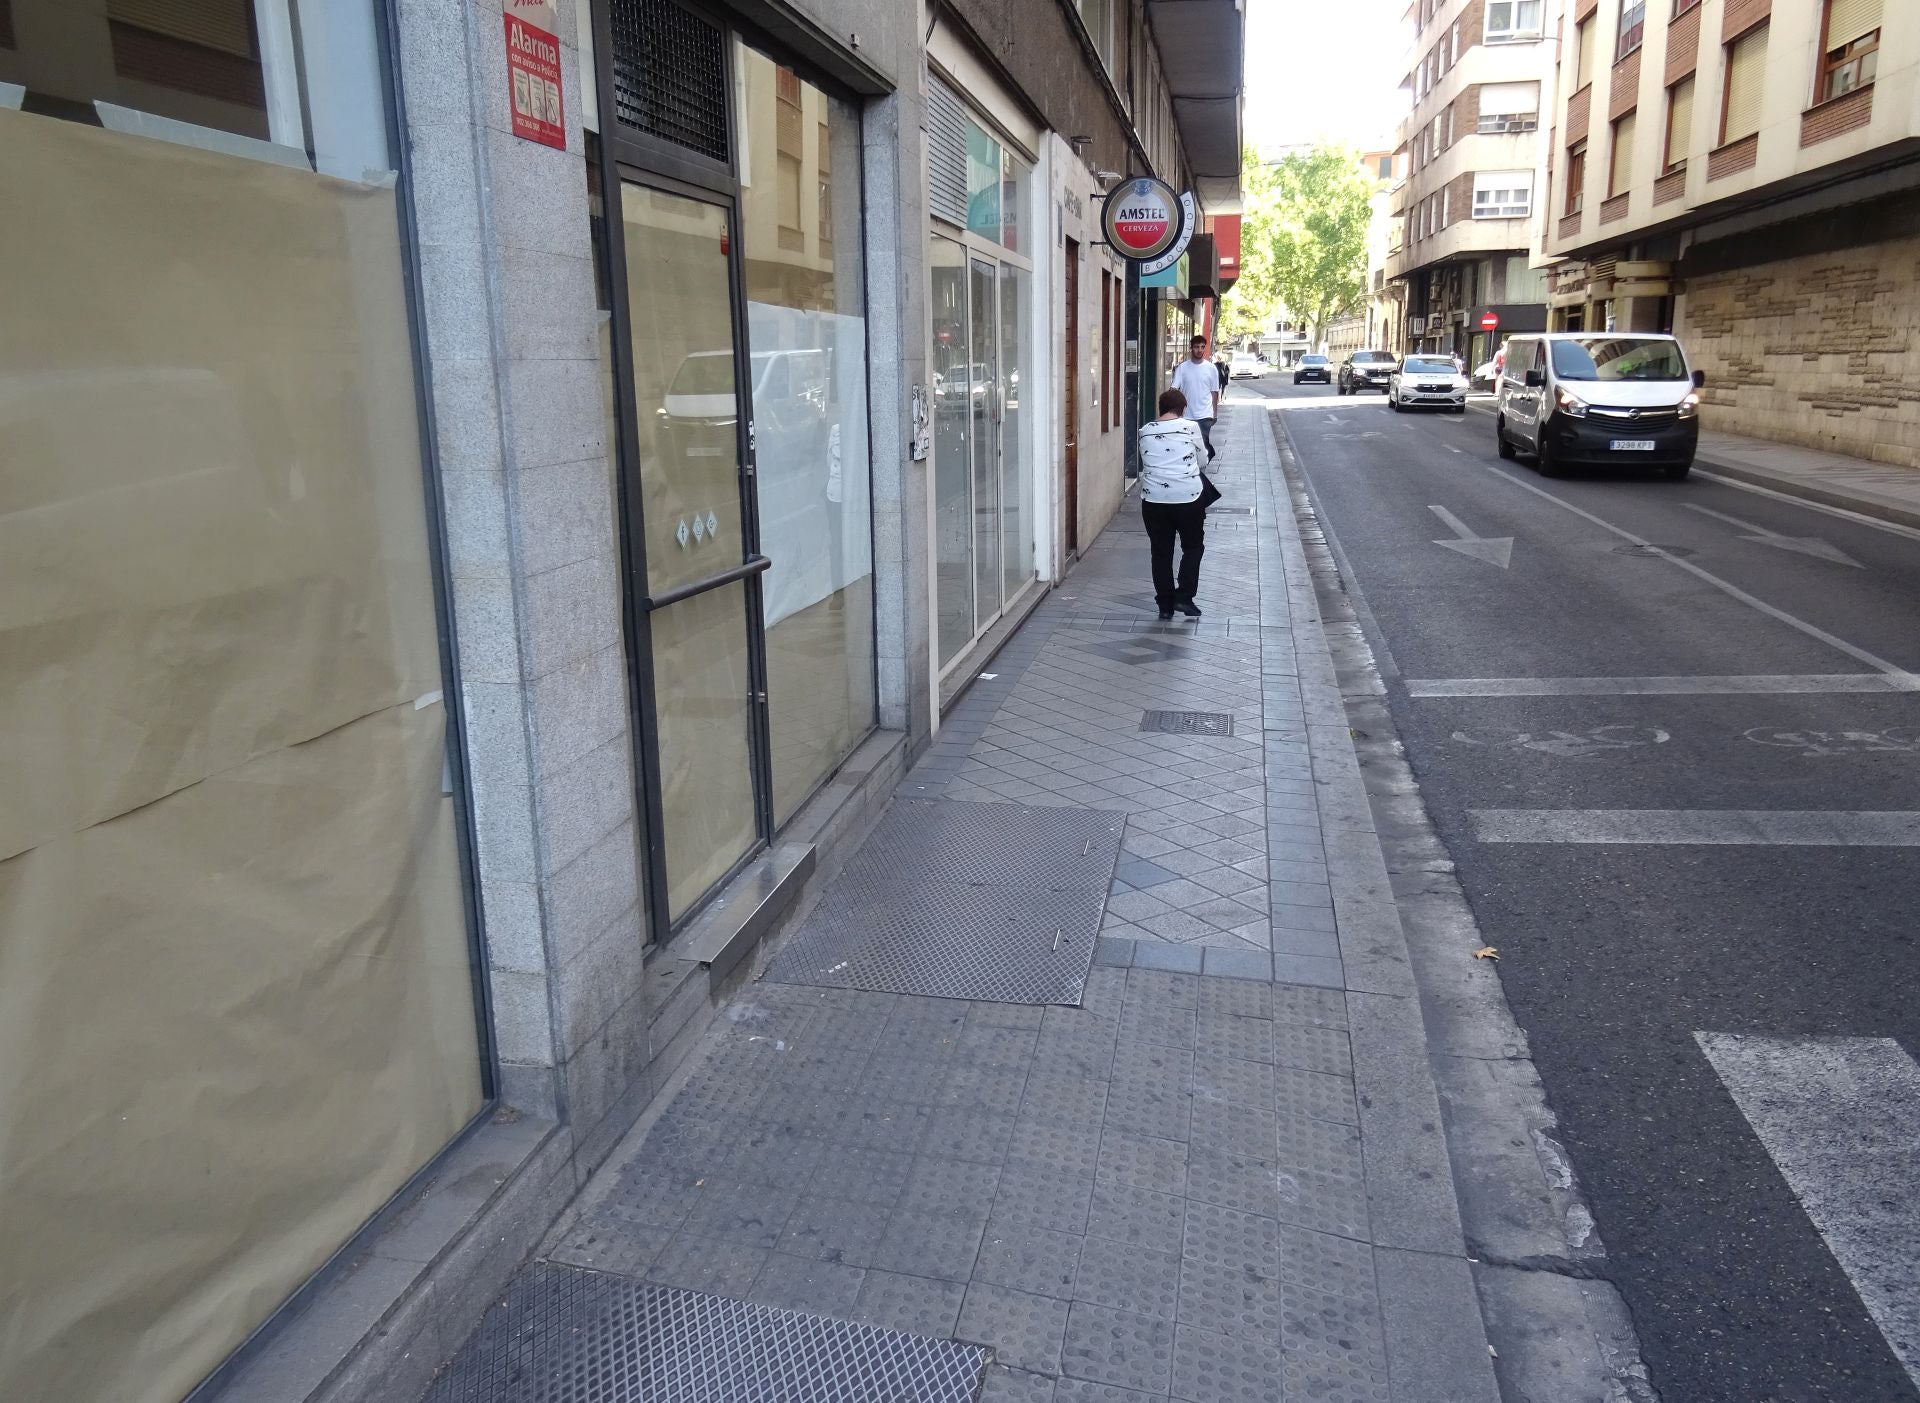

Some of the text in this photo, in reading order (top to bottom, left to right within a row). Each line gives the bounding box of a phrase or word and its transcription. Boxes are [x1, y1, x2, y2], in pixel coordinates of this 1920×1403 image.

[511, 22, 557, 65] Alarma
[511, 53, 521, 64] con
[1119, 207, 1165, 220] AMSTEL
